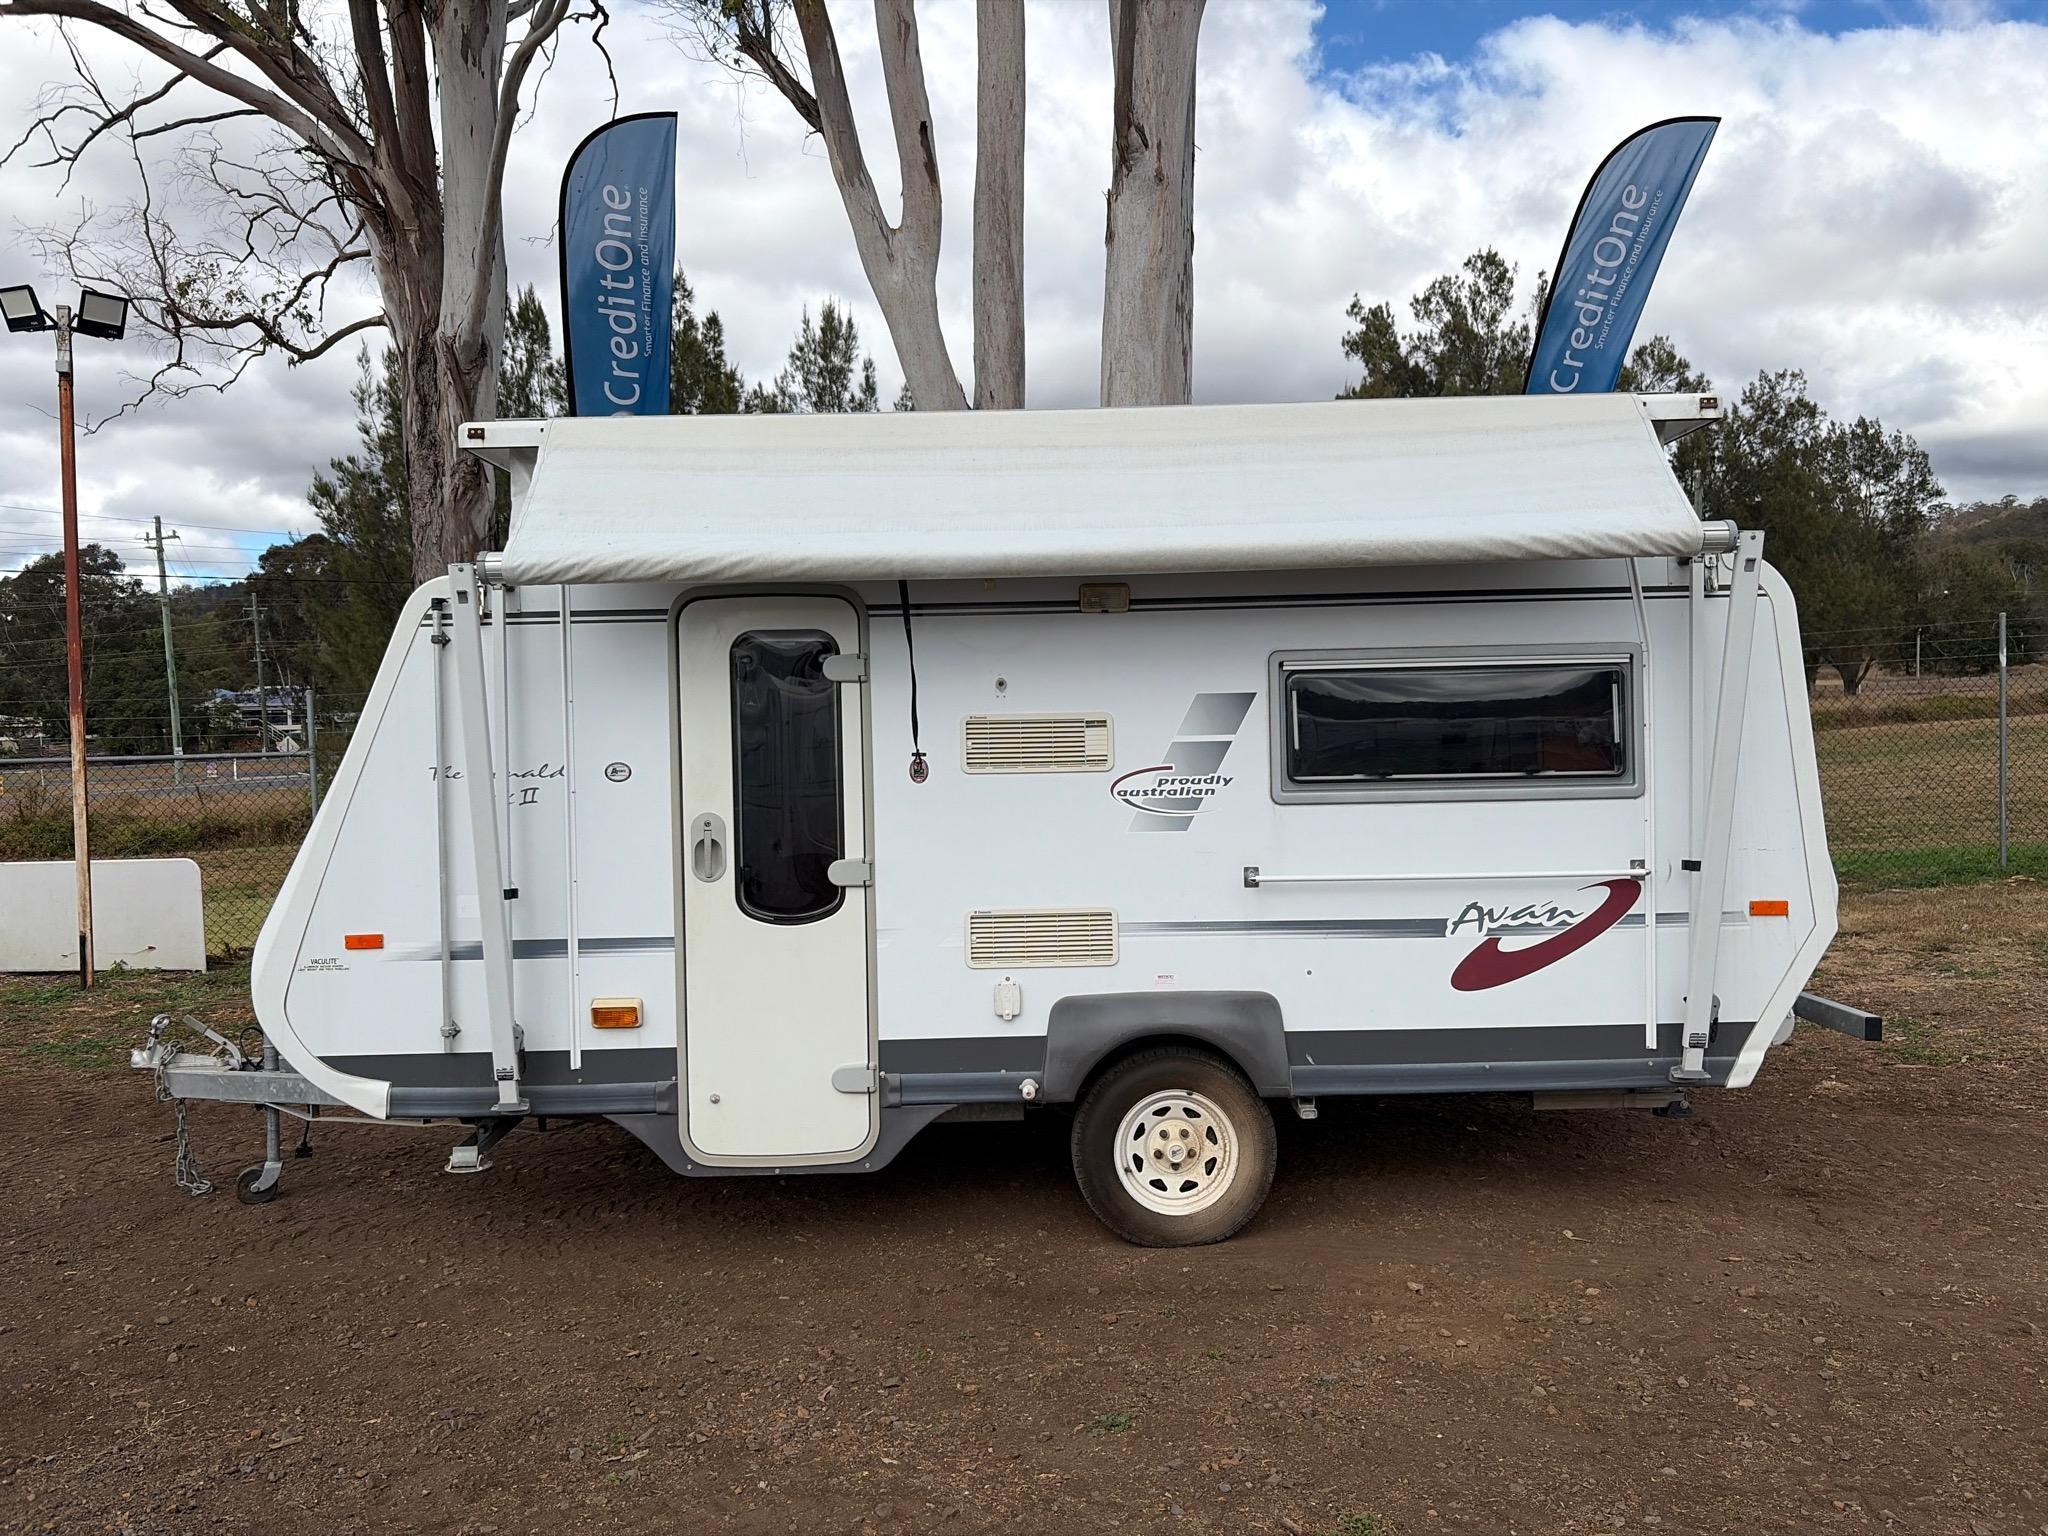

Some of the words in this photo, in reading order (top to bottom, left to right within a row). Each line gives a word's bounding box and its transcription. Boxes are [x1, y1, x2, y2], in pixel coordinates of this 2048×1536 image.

[638, 187, 649, 241] Insurance
[638, 244, 650, 266] and
[1594, 309, 1616, 350] Smarter
[1611, 266, 1633, 307] Finance
[1630, 244, 1642, 265] and
[1636, 190, 1664, 242] Insurance
[595, 184, 640, 406] CreditOne
[641, 268, 652, 311] Finance
[1550, 184, 1647, 393] CreditOne
[644, 315, 653, 357] Smarter
[1117, 787, 1216, 797] australian
[1157, 775, 1234, 788] proudly
